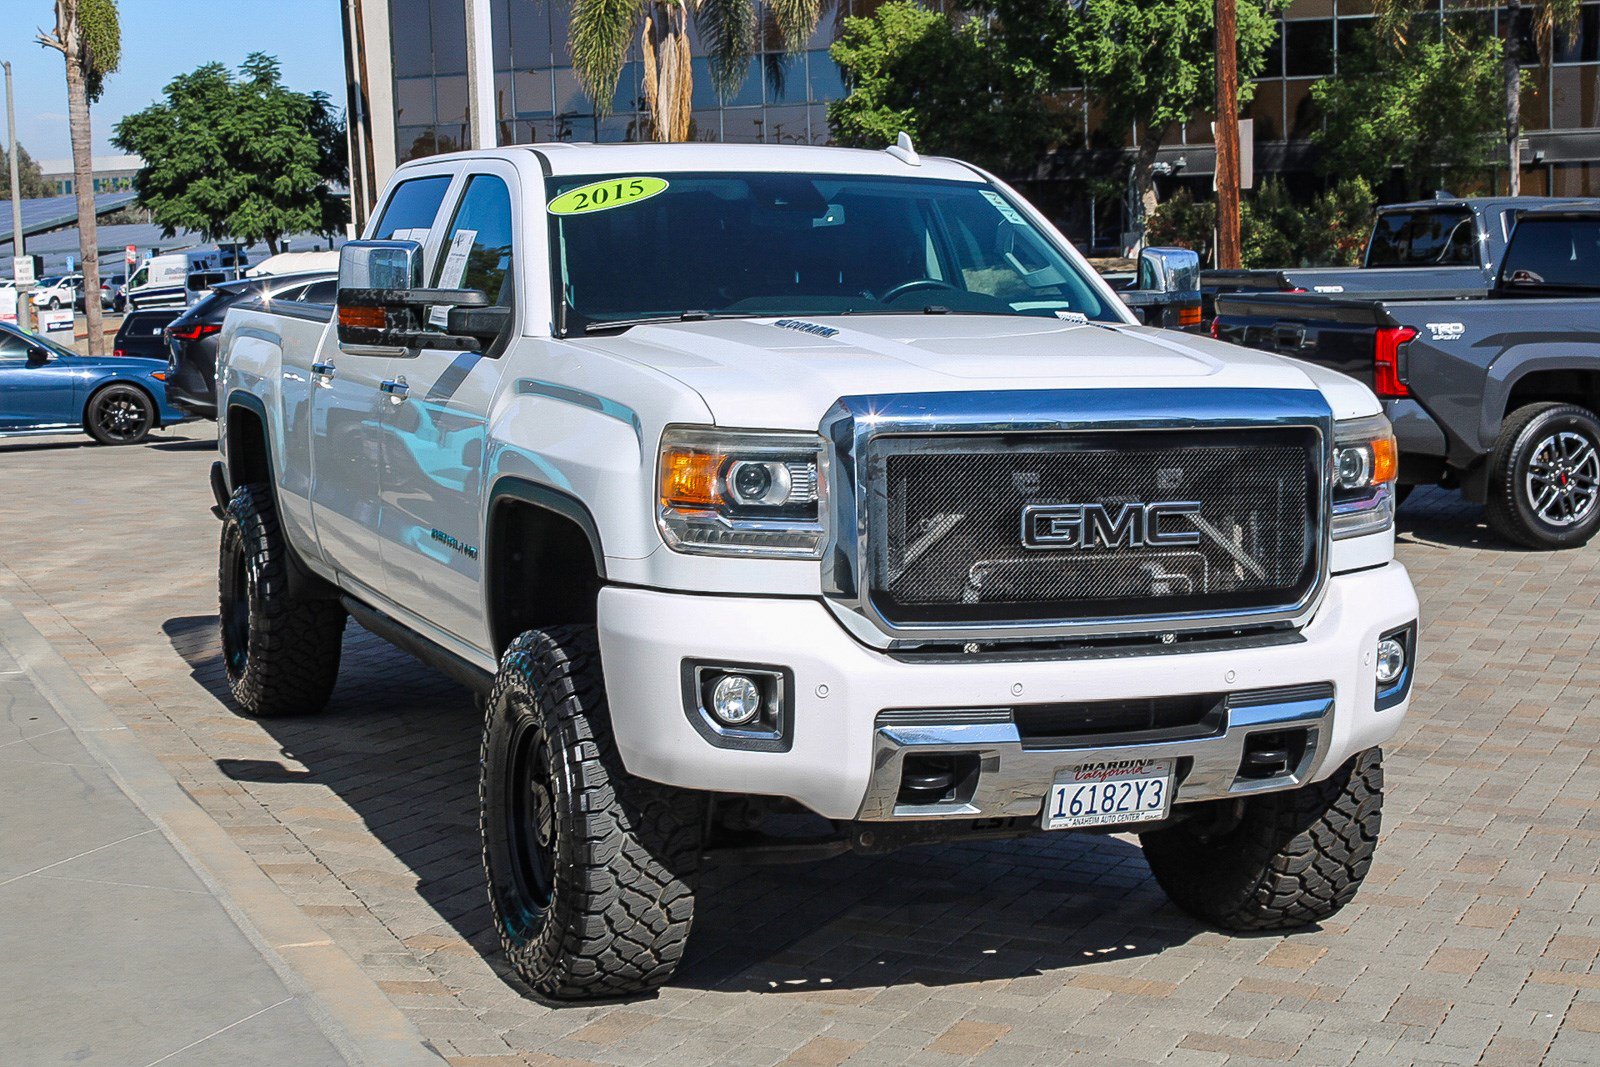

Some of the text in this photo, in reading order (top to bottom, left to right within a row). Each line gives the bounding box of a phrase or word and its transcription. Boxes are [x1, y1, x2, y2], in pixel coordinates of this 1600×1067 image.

[573, 179, 644, 211] 2015
[1425, 322, 1465, 334] TRD
[1021, 500, 1201, 550] GMC
[1082, 758, 1147, 772] HARDIN
[1074, 766, 1150, 783] California
[1053, 780, 1163, 818] 16182Y3
[1072, 815, 1100, 826] ANAHEIM
[1100, 814, 1117, 824] AUTO
[1117, 811, 1141, 823] CENTER
